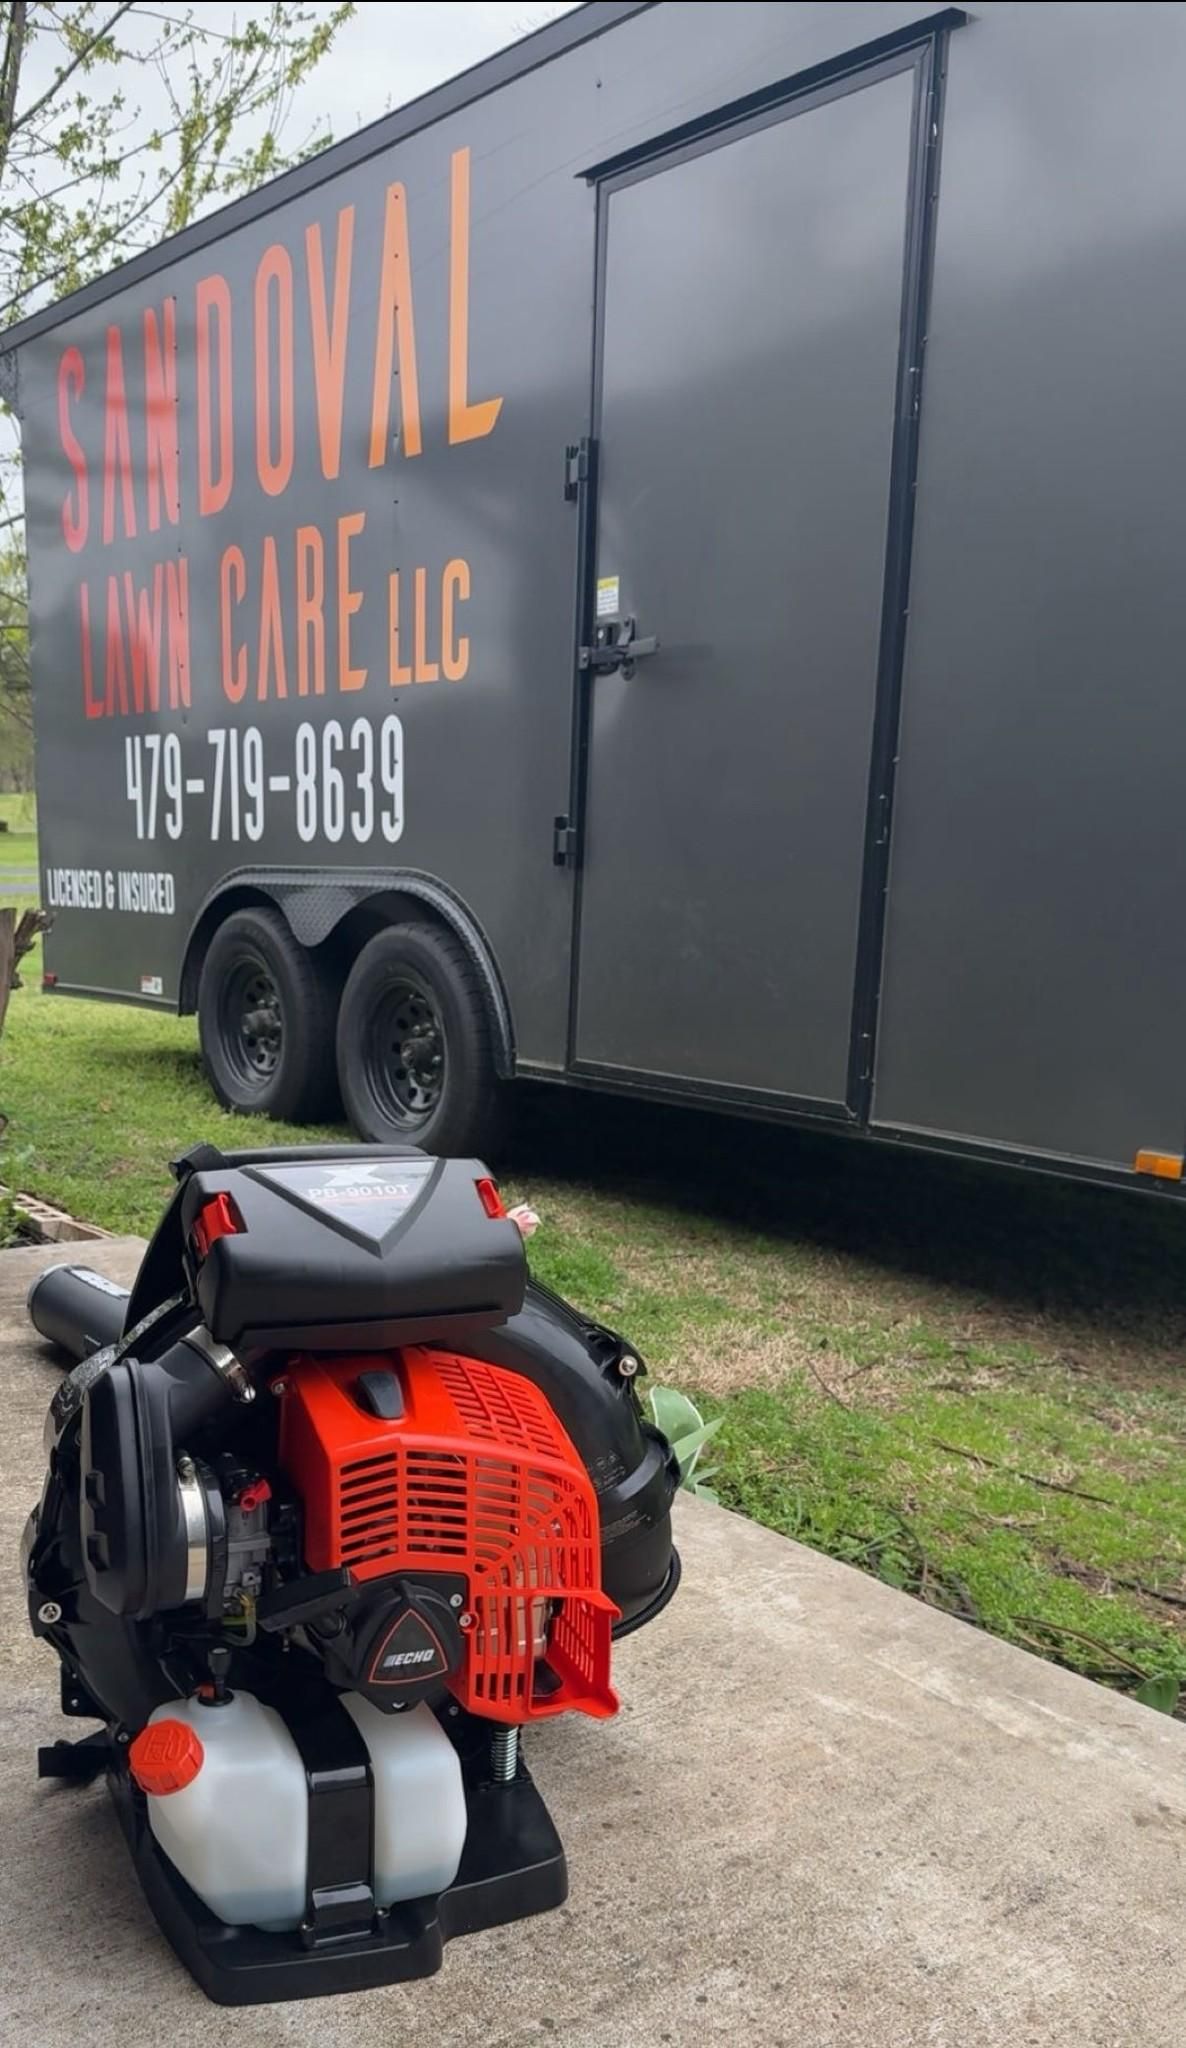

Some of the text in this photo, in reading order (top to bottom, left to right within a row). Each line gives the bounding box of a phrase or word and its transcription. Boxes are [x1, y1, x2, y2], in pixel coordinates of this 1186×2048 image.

[57, 146, 504, 553] SANDOVAL
[81, 512, 471, 720] LAWN CARE LLC
[125, 714, 404, 843] 479-719-8639
[47, 868, 176, 915] LICENSED & INSURED
[307, 1183, 411, 1200] PB-9010T
[394, 1648, 435, 1666] ECHO
